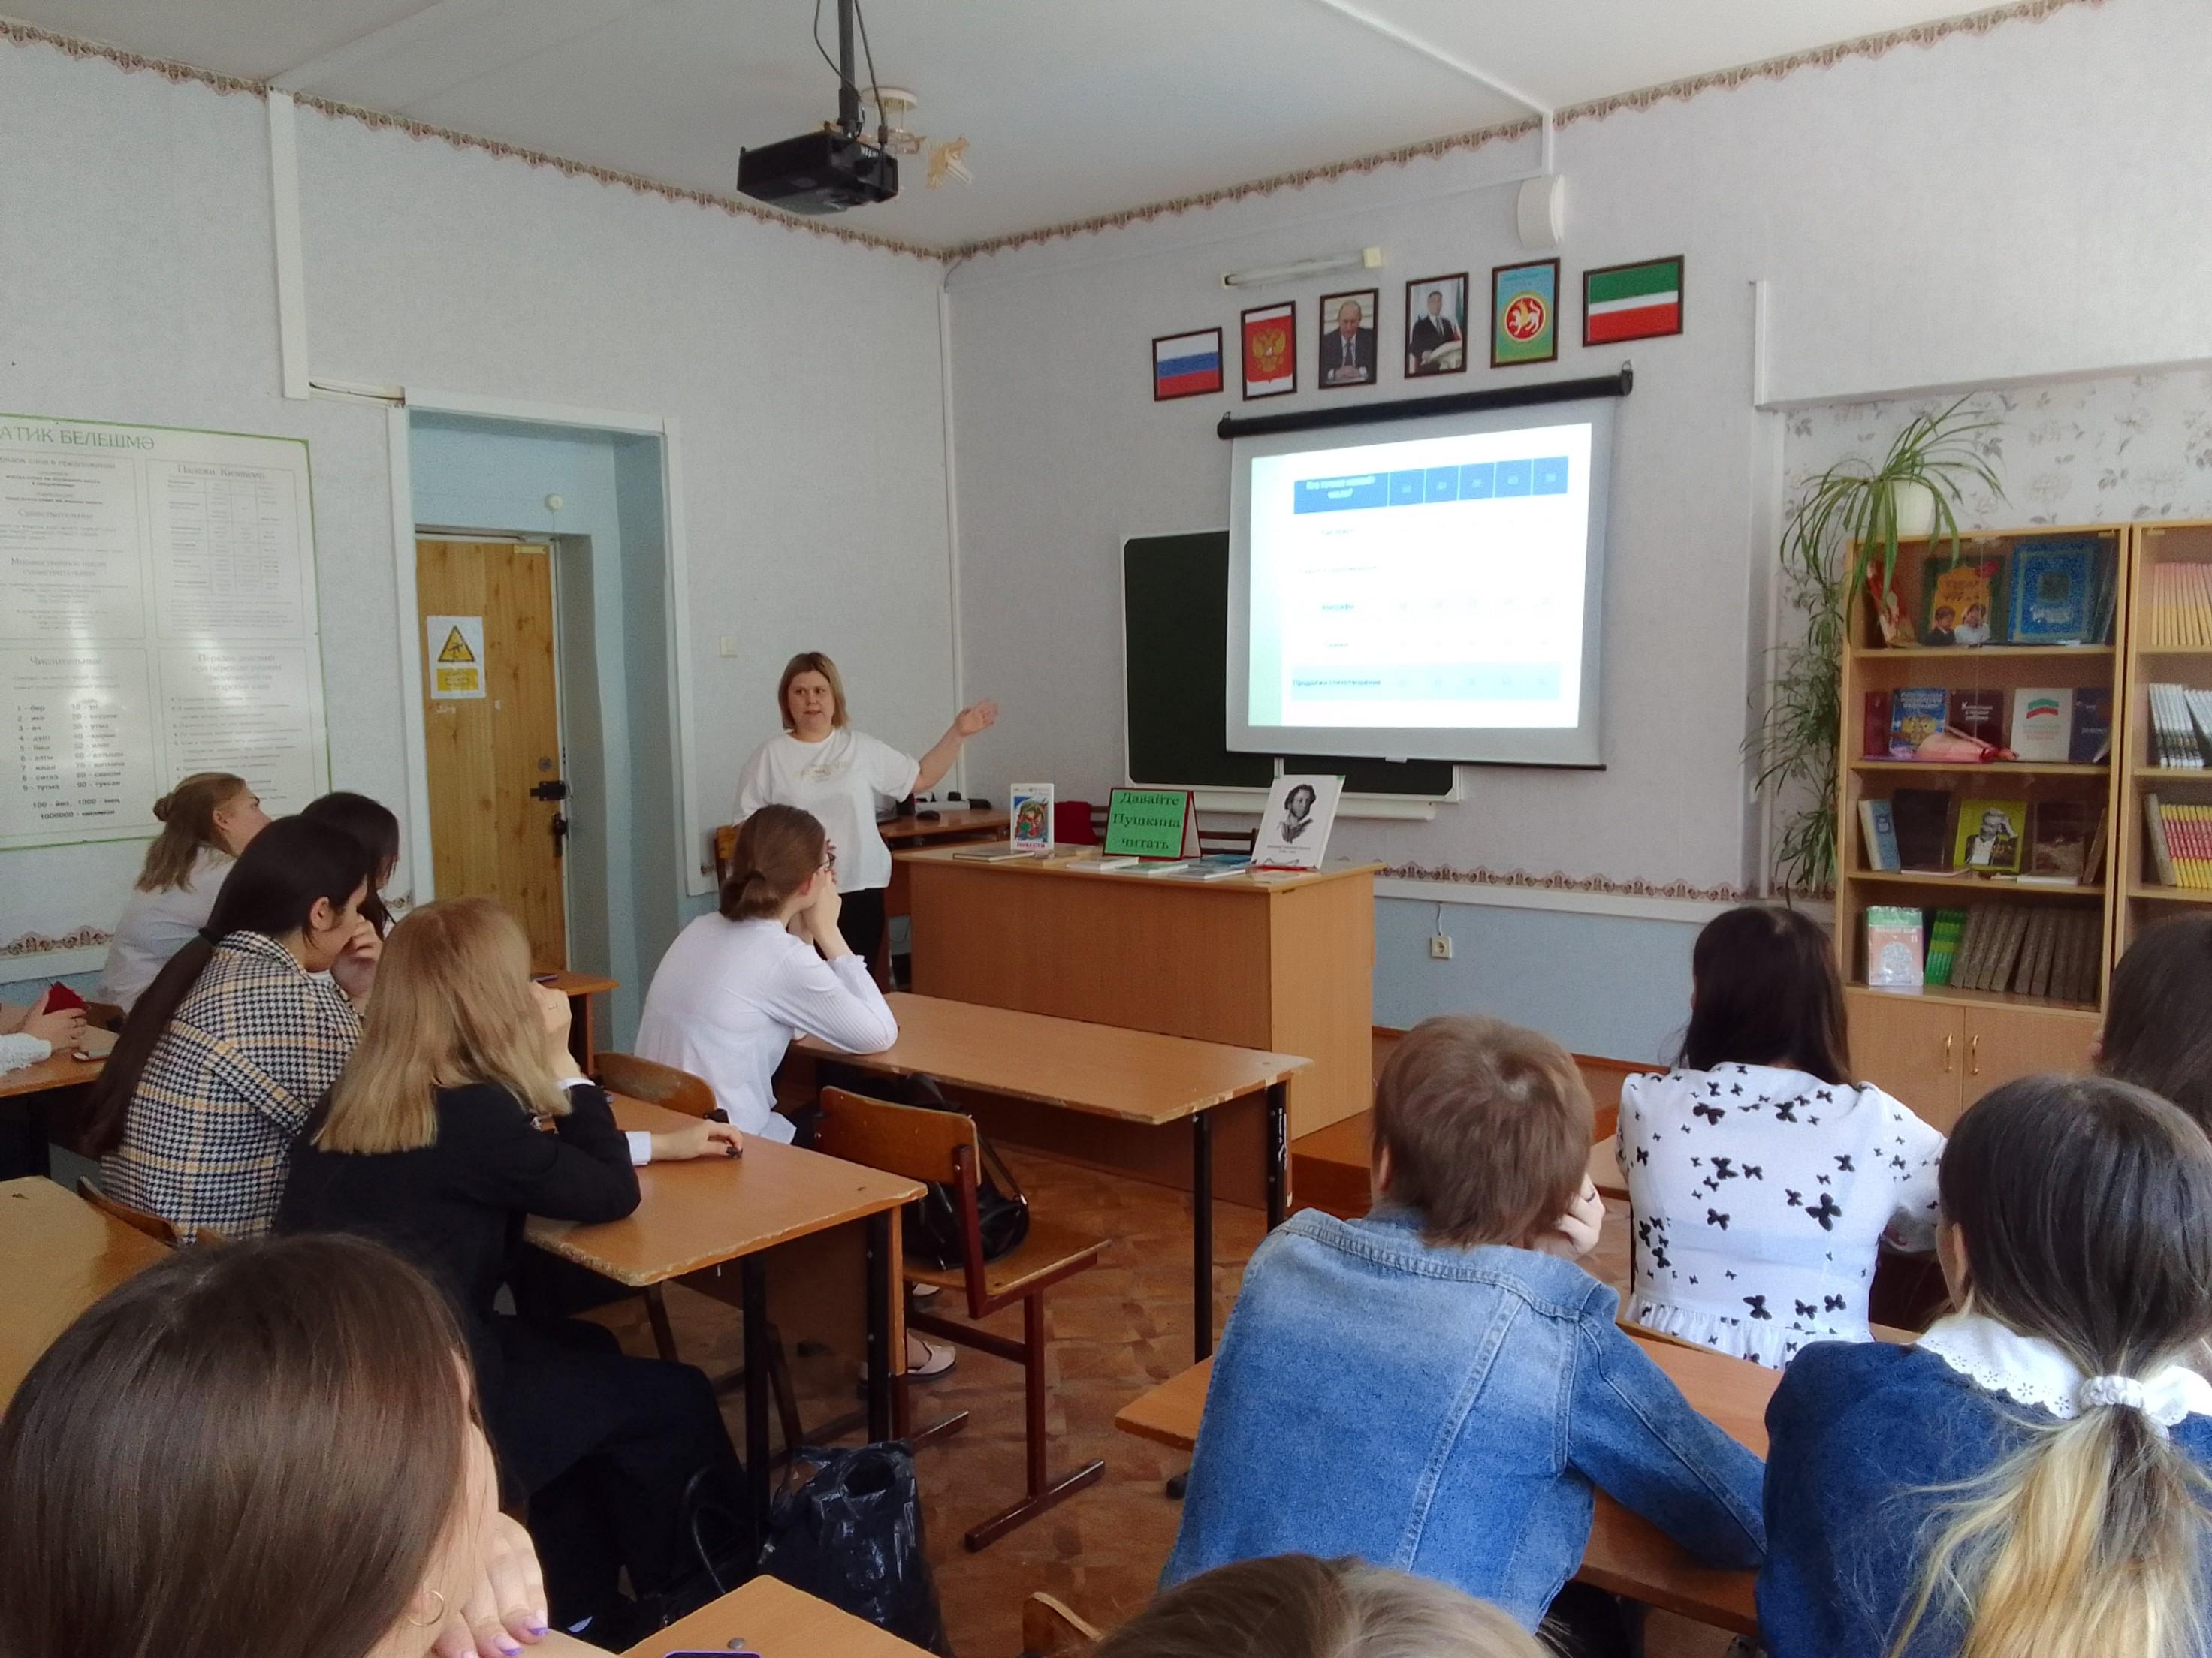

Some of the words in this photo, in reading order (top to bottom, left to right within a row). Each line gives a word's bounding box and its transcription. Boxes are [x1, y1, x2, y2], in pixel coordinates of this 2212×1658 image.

[59, 430, 155, 450] БЕЛЕШМӘ
[1119, 792, 1180, 806] Давайте
[1113, 813, 1180, 828] Пушкина
[1122, 837, 1169, 849] читать
